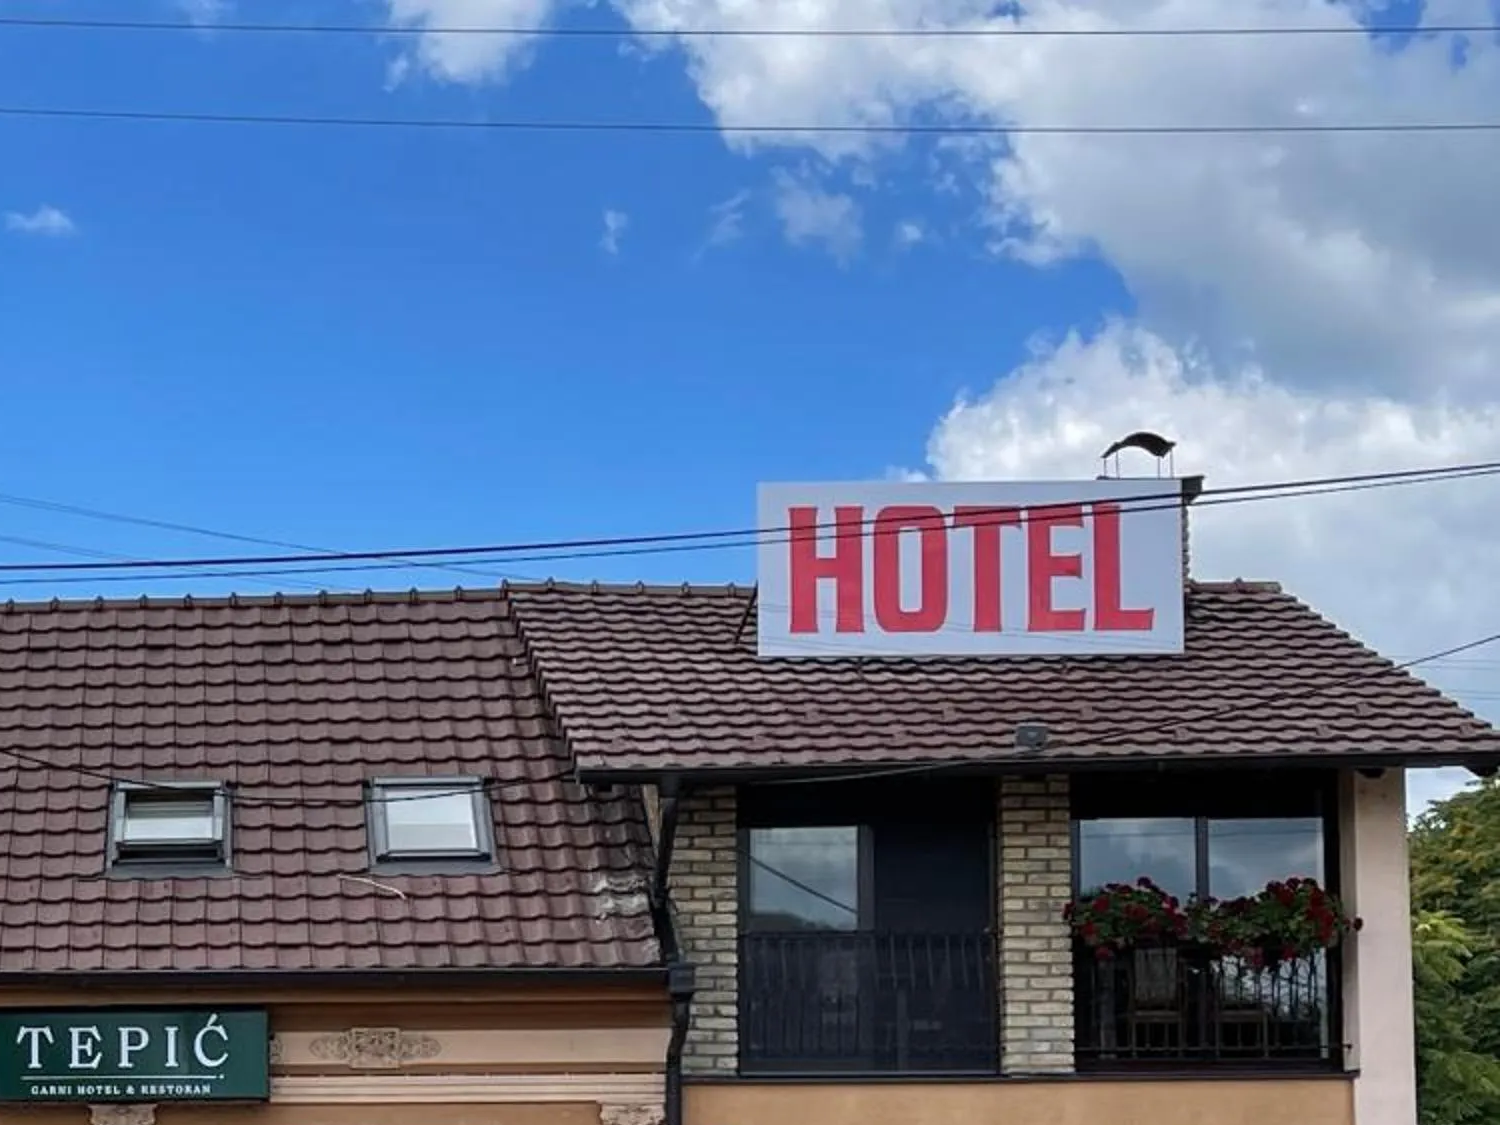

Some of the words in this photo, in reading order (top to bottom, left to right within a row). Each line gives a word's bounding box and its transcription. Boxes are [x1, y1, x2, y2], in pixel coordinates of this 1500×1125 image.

[787, 504, 1156, 634] HOTEL
[16, 1013, 229, 1069] TEPIĆ
[77, 1085, 121, 1096] HOTEL
[126, 1085, 135, 1095] &
[141, 1084, 211, 1095] RESTORAN
